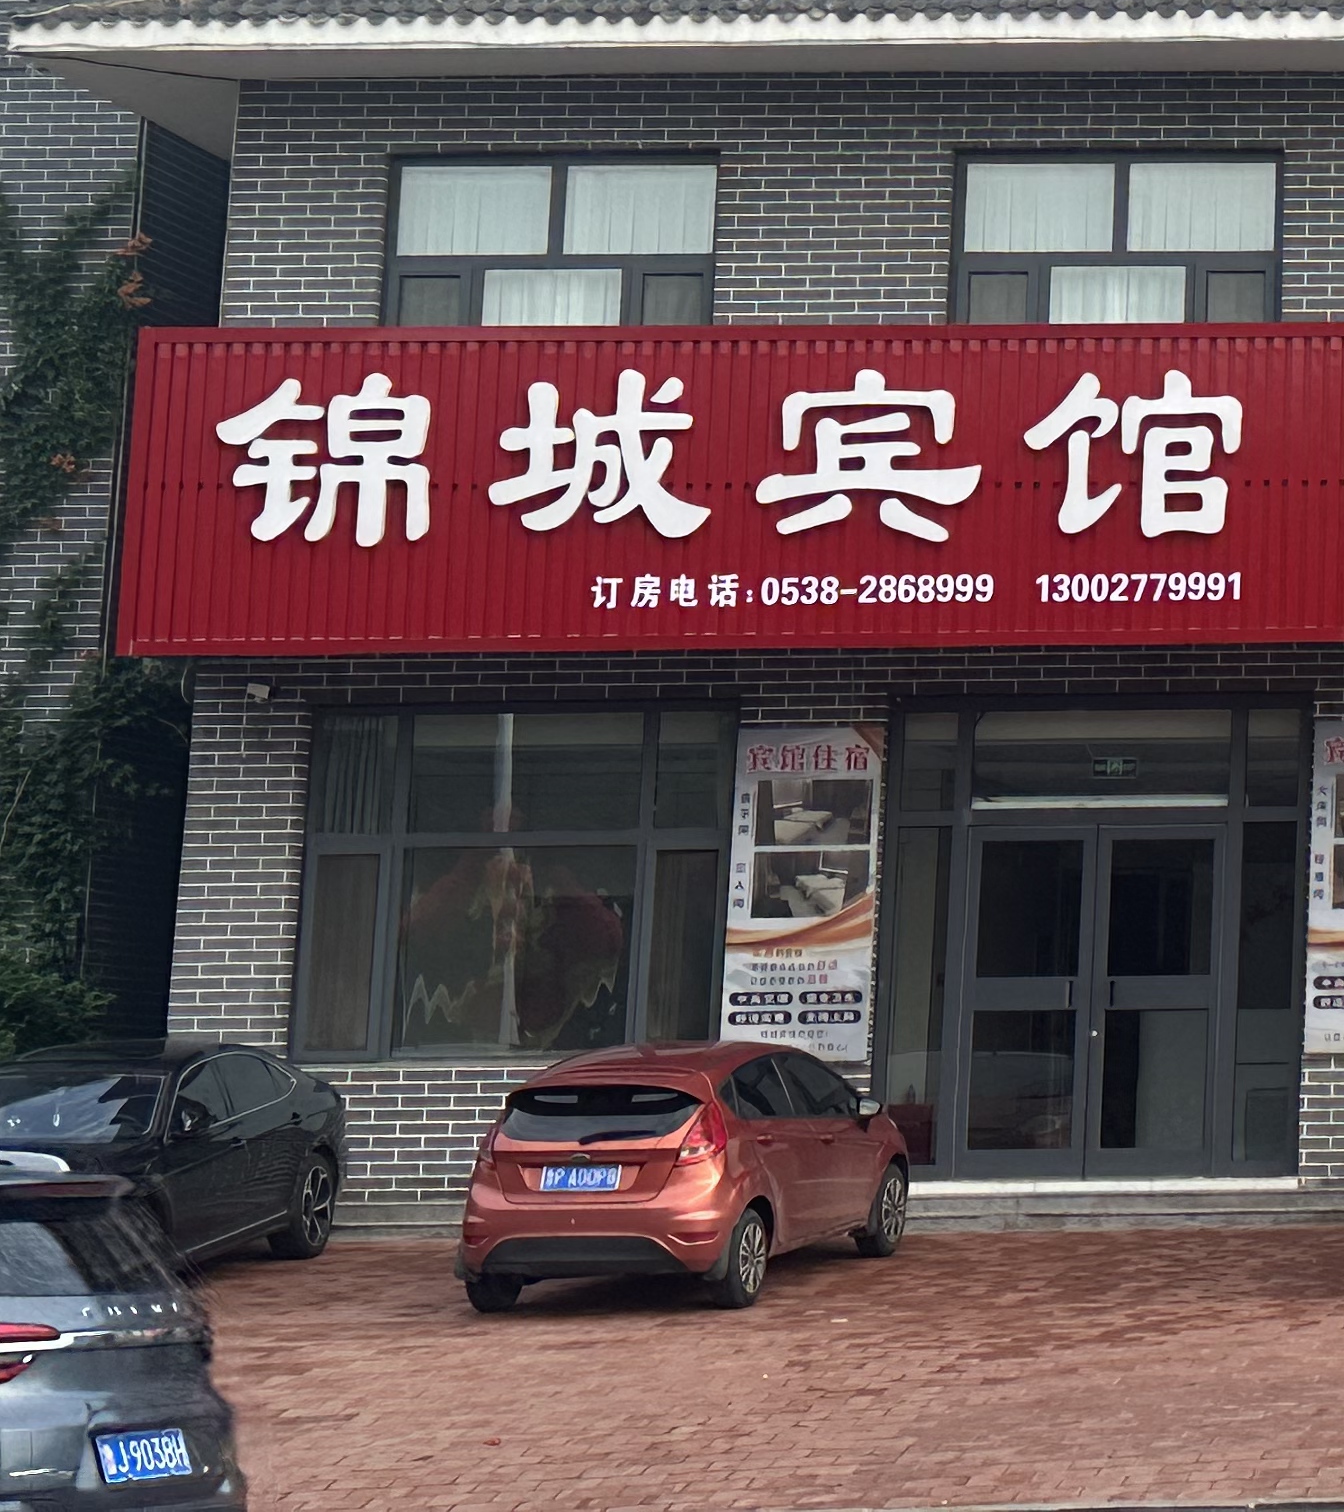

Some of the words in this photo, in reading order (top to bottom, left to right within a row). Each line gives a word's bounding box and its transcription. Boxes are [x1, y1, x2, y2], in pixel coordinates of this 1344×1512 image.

[216, 368, 1244, 547] 锦城宾馆
[1035, 571, 1244, 604] 13002779991
